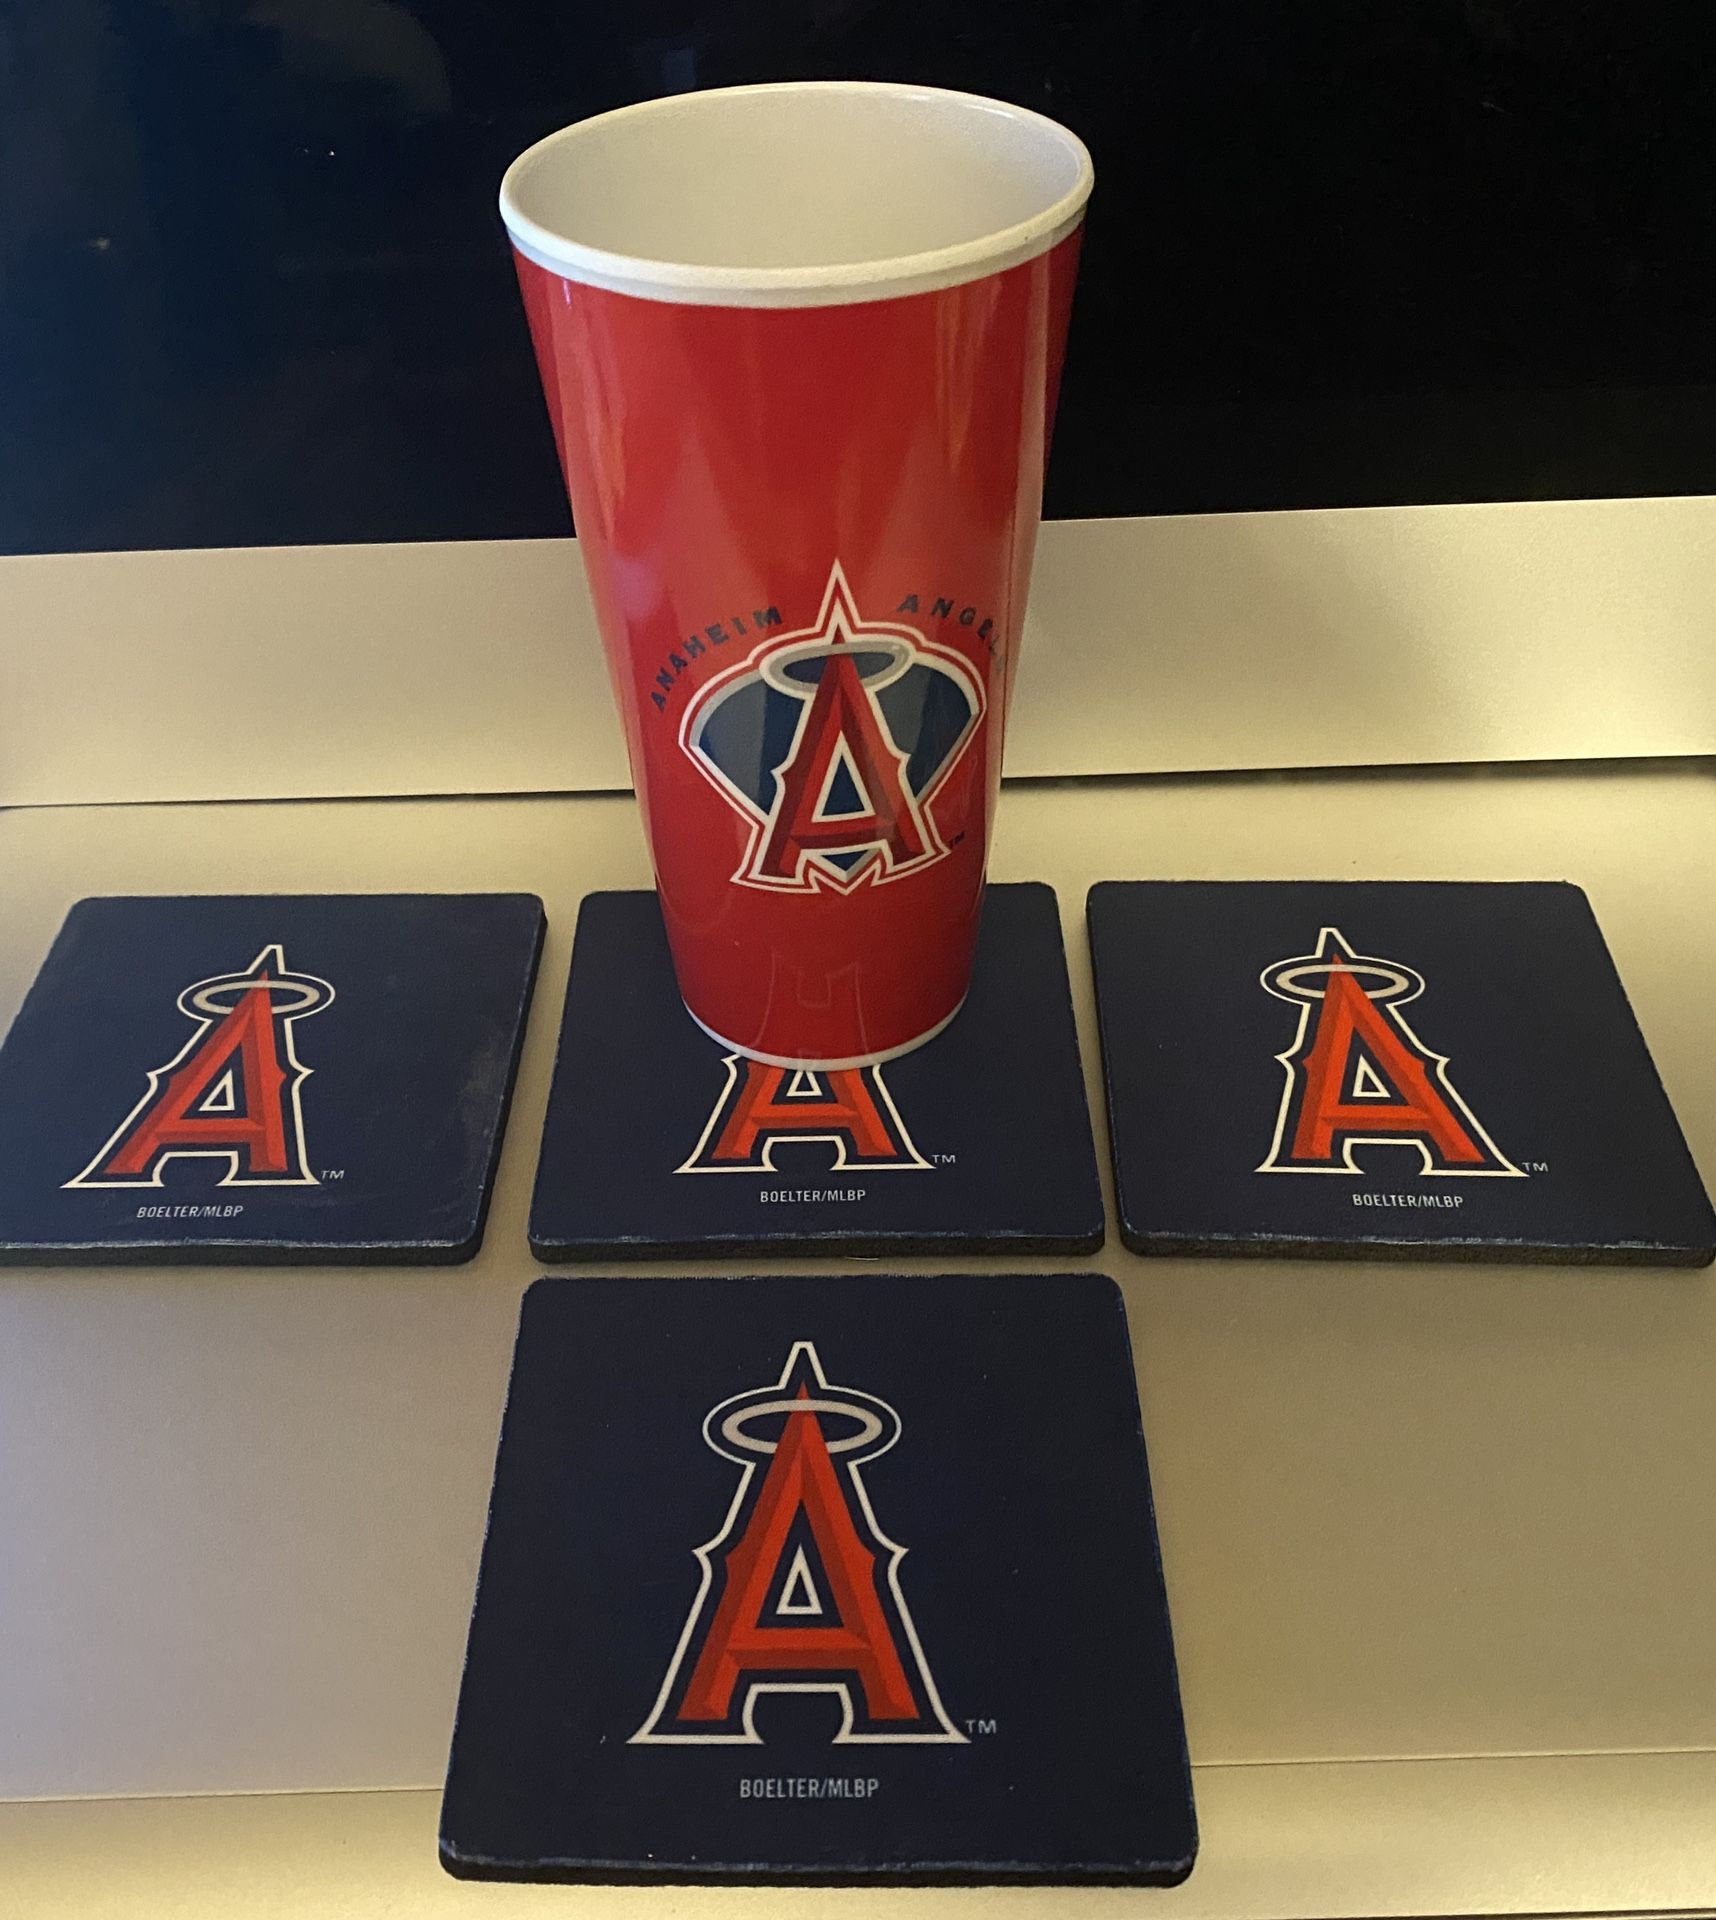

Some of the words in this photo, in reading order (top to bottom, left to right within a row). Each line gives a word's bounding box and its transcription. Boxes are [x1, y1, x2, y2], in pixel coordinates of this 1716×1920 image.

[651, 606, 783, 712] ANAHEIM
[1254, 928, 1530, 1178] A
[60, 944, 321, 1188] A
[932, 1154, 957, 1163] TM
[321, 1169, 345, 1180] TM
[1522, 1162, 1549, 1173] TM
[759, 1188, 867, 1204] BOELTER/MLBP
[1351, 1192, 1464, 1209] BOELTER/MLBP
[135, 1204, 244, 1219] BOELTER/MLBP
[626, 1341, 971, 1745] A
[965, 1719, 998, 1736] TM
[739, 1777, 880, 1799] BOELTER/MLBP
